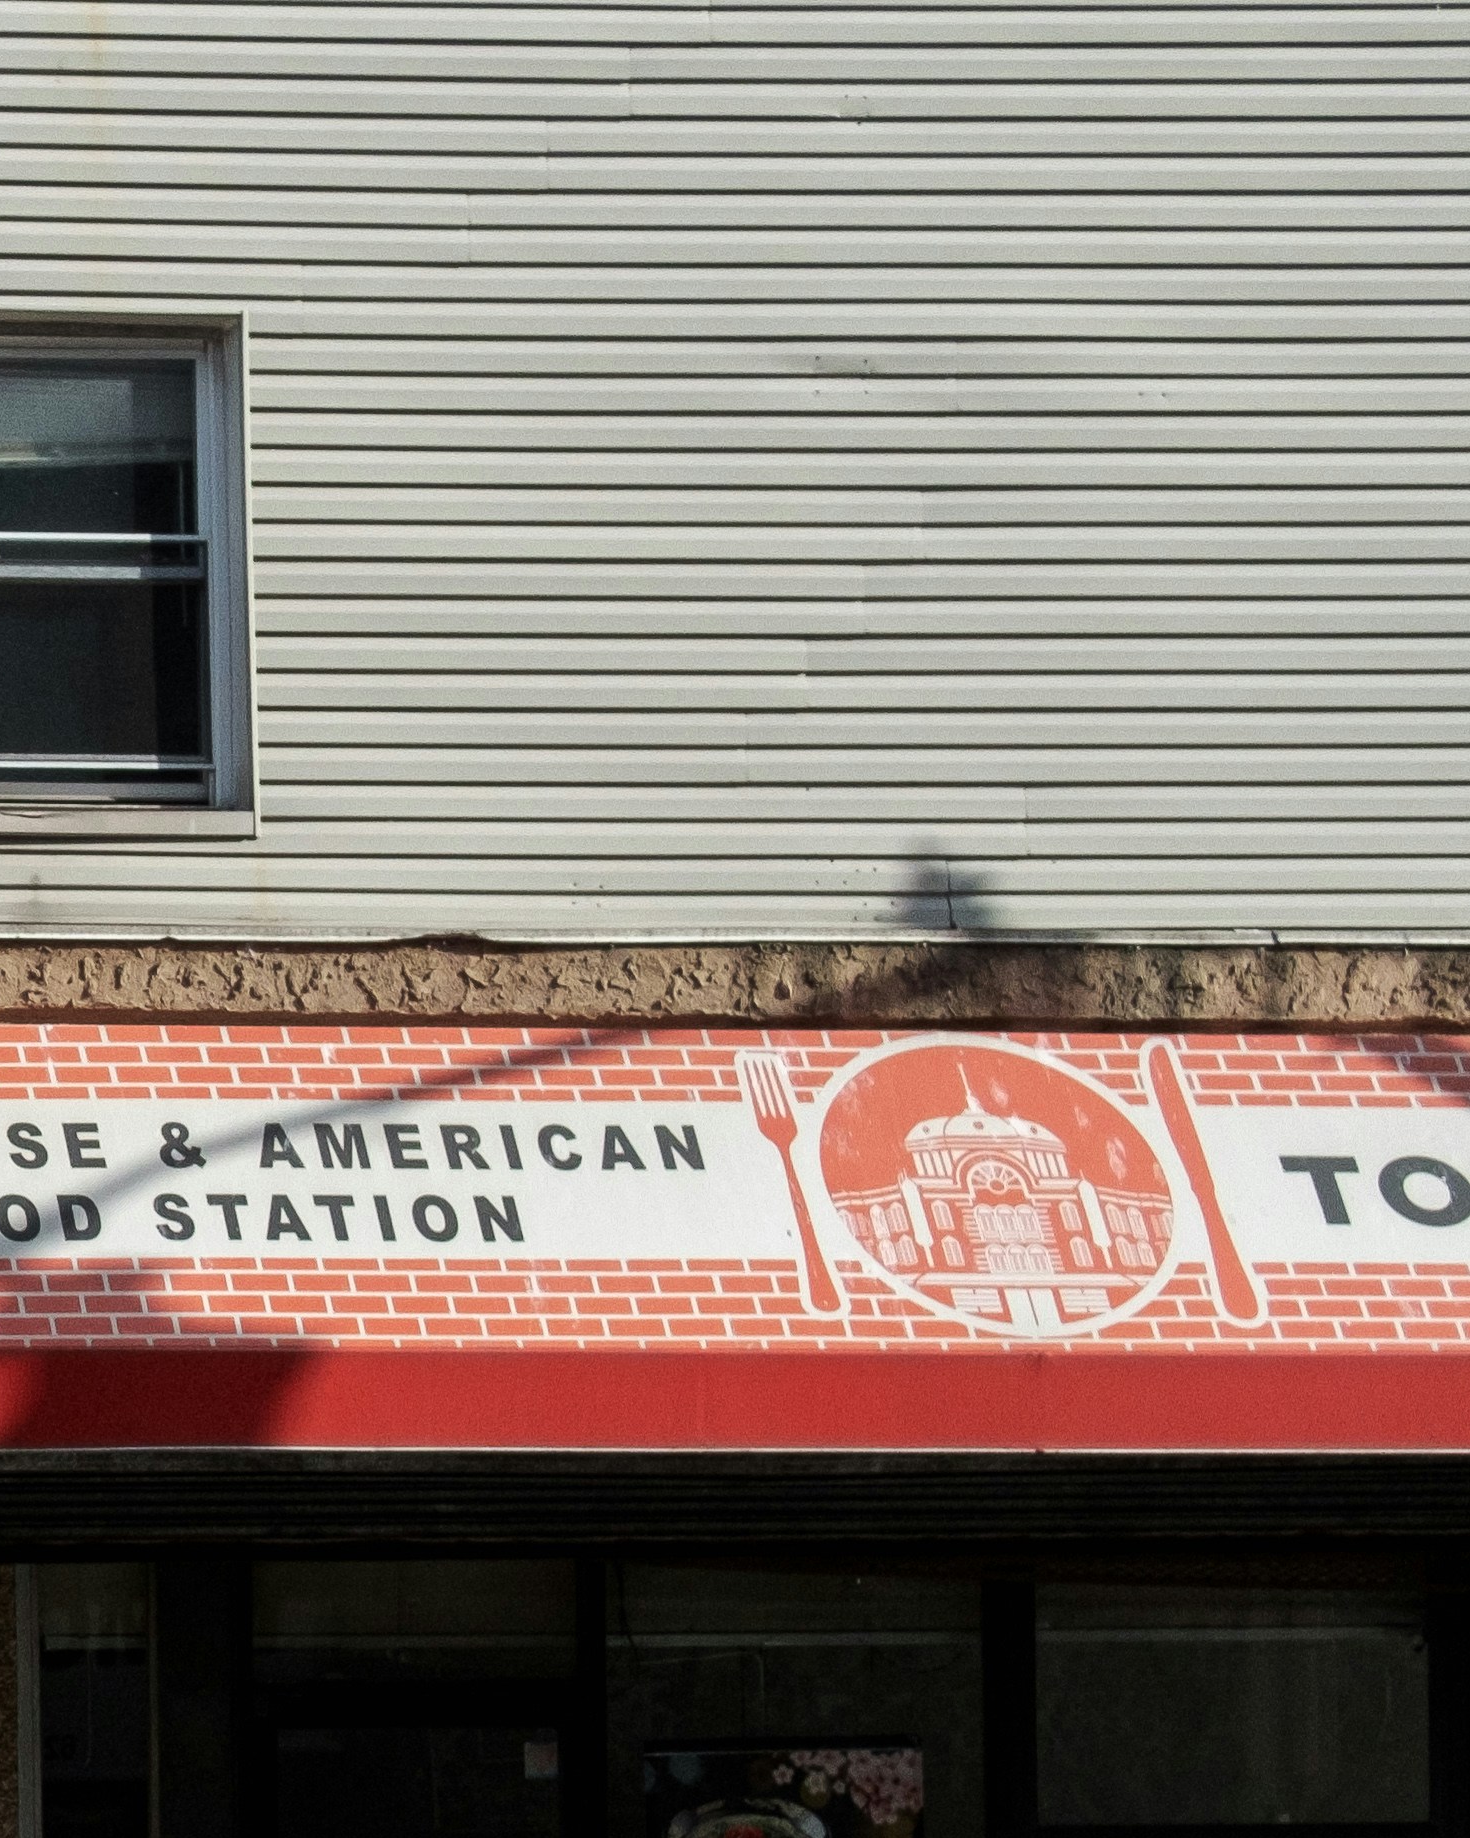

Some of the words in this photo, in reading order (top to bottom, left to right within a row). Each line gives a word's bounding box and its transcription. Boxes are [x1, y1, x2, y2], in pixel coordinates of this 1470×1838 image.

[158, 1122, 208, 1169] &
[260, 1122, 706, 1171] AMERICAN
[1279, 1156, 1470, 1227] TO
[154, 1194, 524, 1243] STATION
